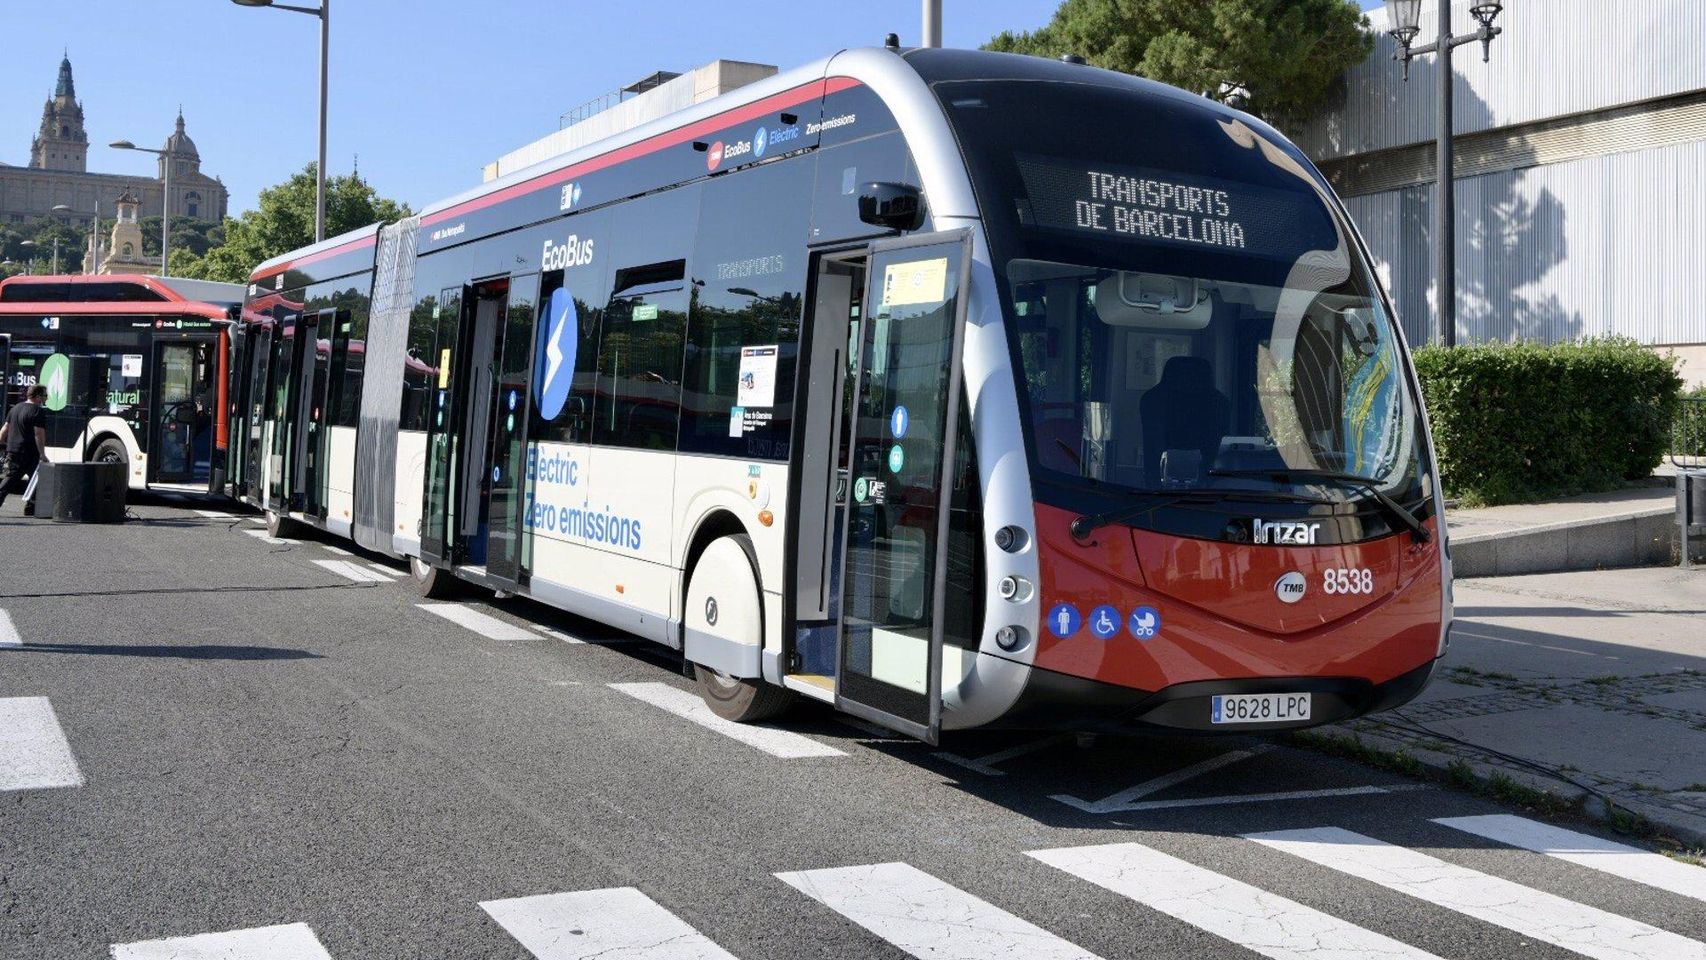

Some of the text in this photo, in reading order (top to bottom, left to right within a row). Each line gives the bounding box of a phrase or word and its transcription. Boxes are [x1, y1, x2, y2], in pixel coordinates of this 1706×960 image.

[724, 113, 855, 159] EcoBus Elèctric Zero emissions
[1088, 171, 1230, 217] TRANSPORTS
[1076, 200, 1245, 248] DE BARCELONA
[542, 234, 594, 272] EcoBus
[717, 254, 784, 280] TRANSPORTS
[106, 389, 140, 405] atural
[526, 446, 578, 487] Elèctric
[525, 492, 641, 550] Zero emissions
[1253, 518, 1321, 545] Irizar
[1284, 583, 1304, 593] TMB
[1323, 568, 1373, 595] 8538
[1225, 696, 1307, 719] 9628 LPC
